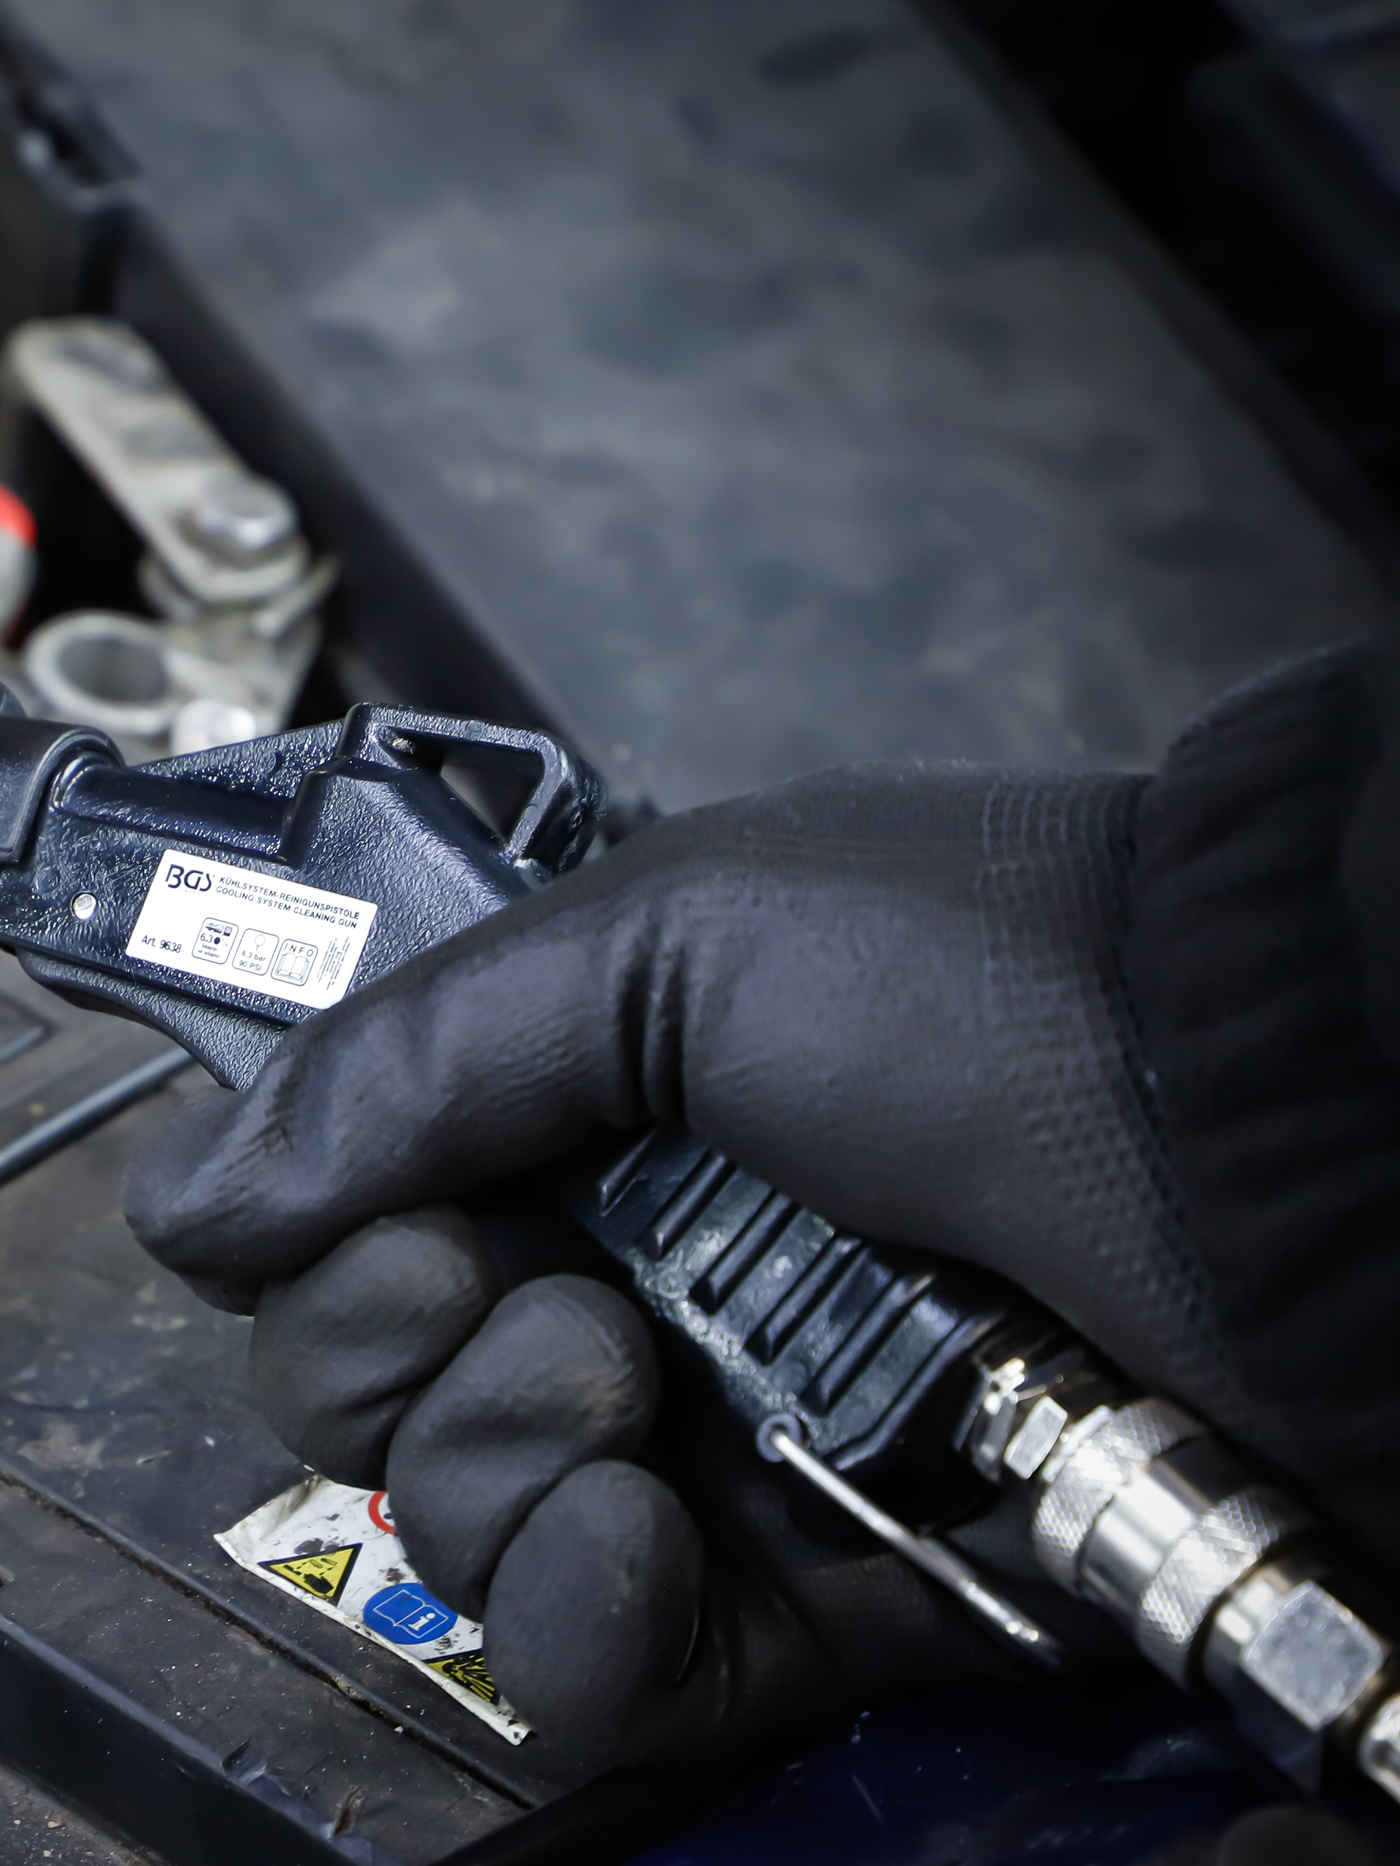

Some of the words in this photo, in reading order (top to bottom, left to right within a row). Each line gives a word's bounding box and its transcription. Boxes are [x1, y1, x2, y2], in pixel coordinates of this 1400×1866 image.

[165, 863, 212, 892] BGS
[216, 885, 254, 902] COOLING
[257, 896, 292, 912] SYSTEM
[293, 906, 336, 924] CLEANING
[338, 918, 358, 929] GUN
[159, 939, 182, 953] 9638
[253, 954, 266, 962] bar
